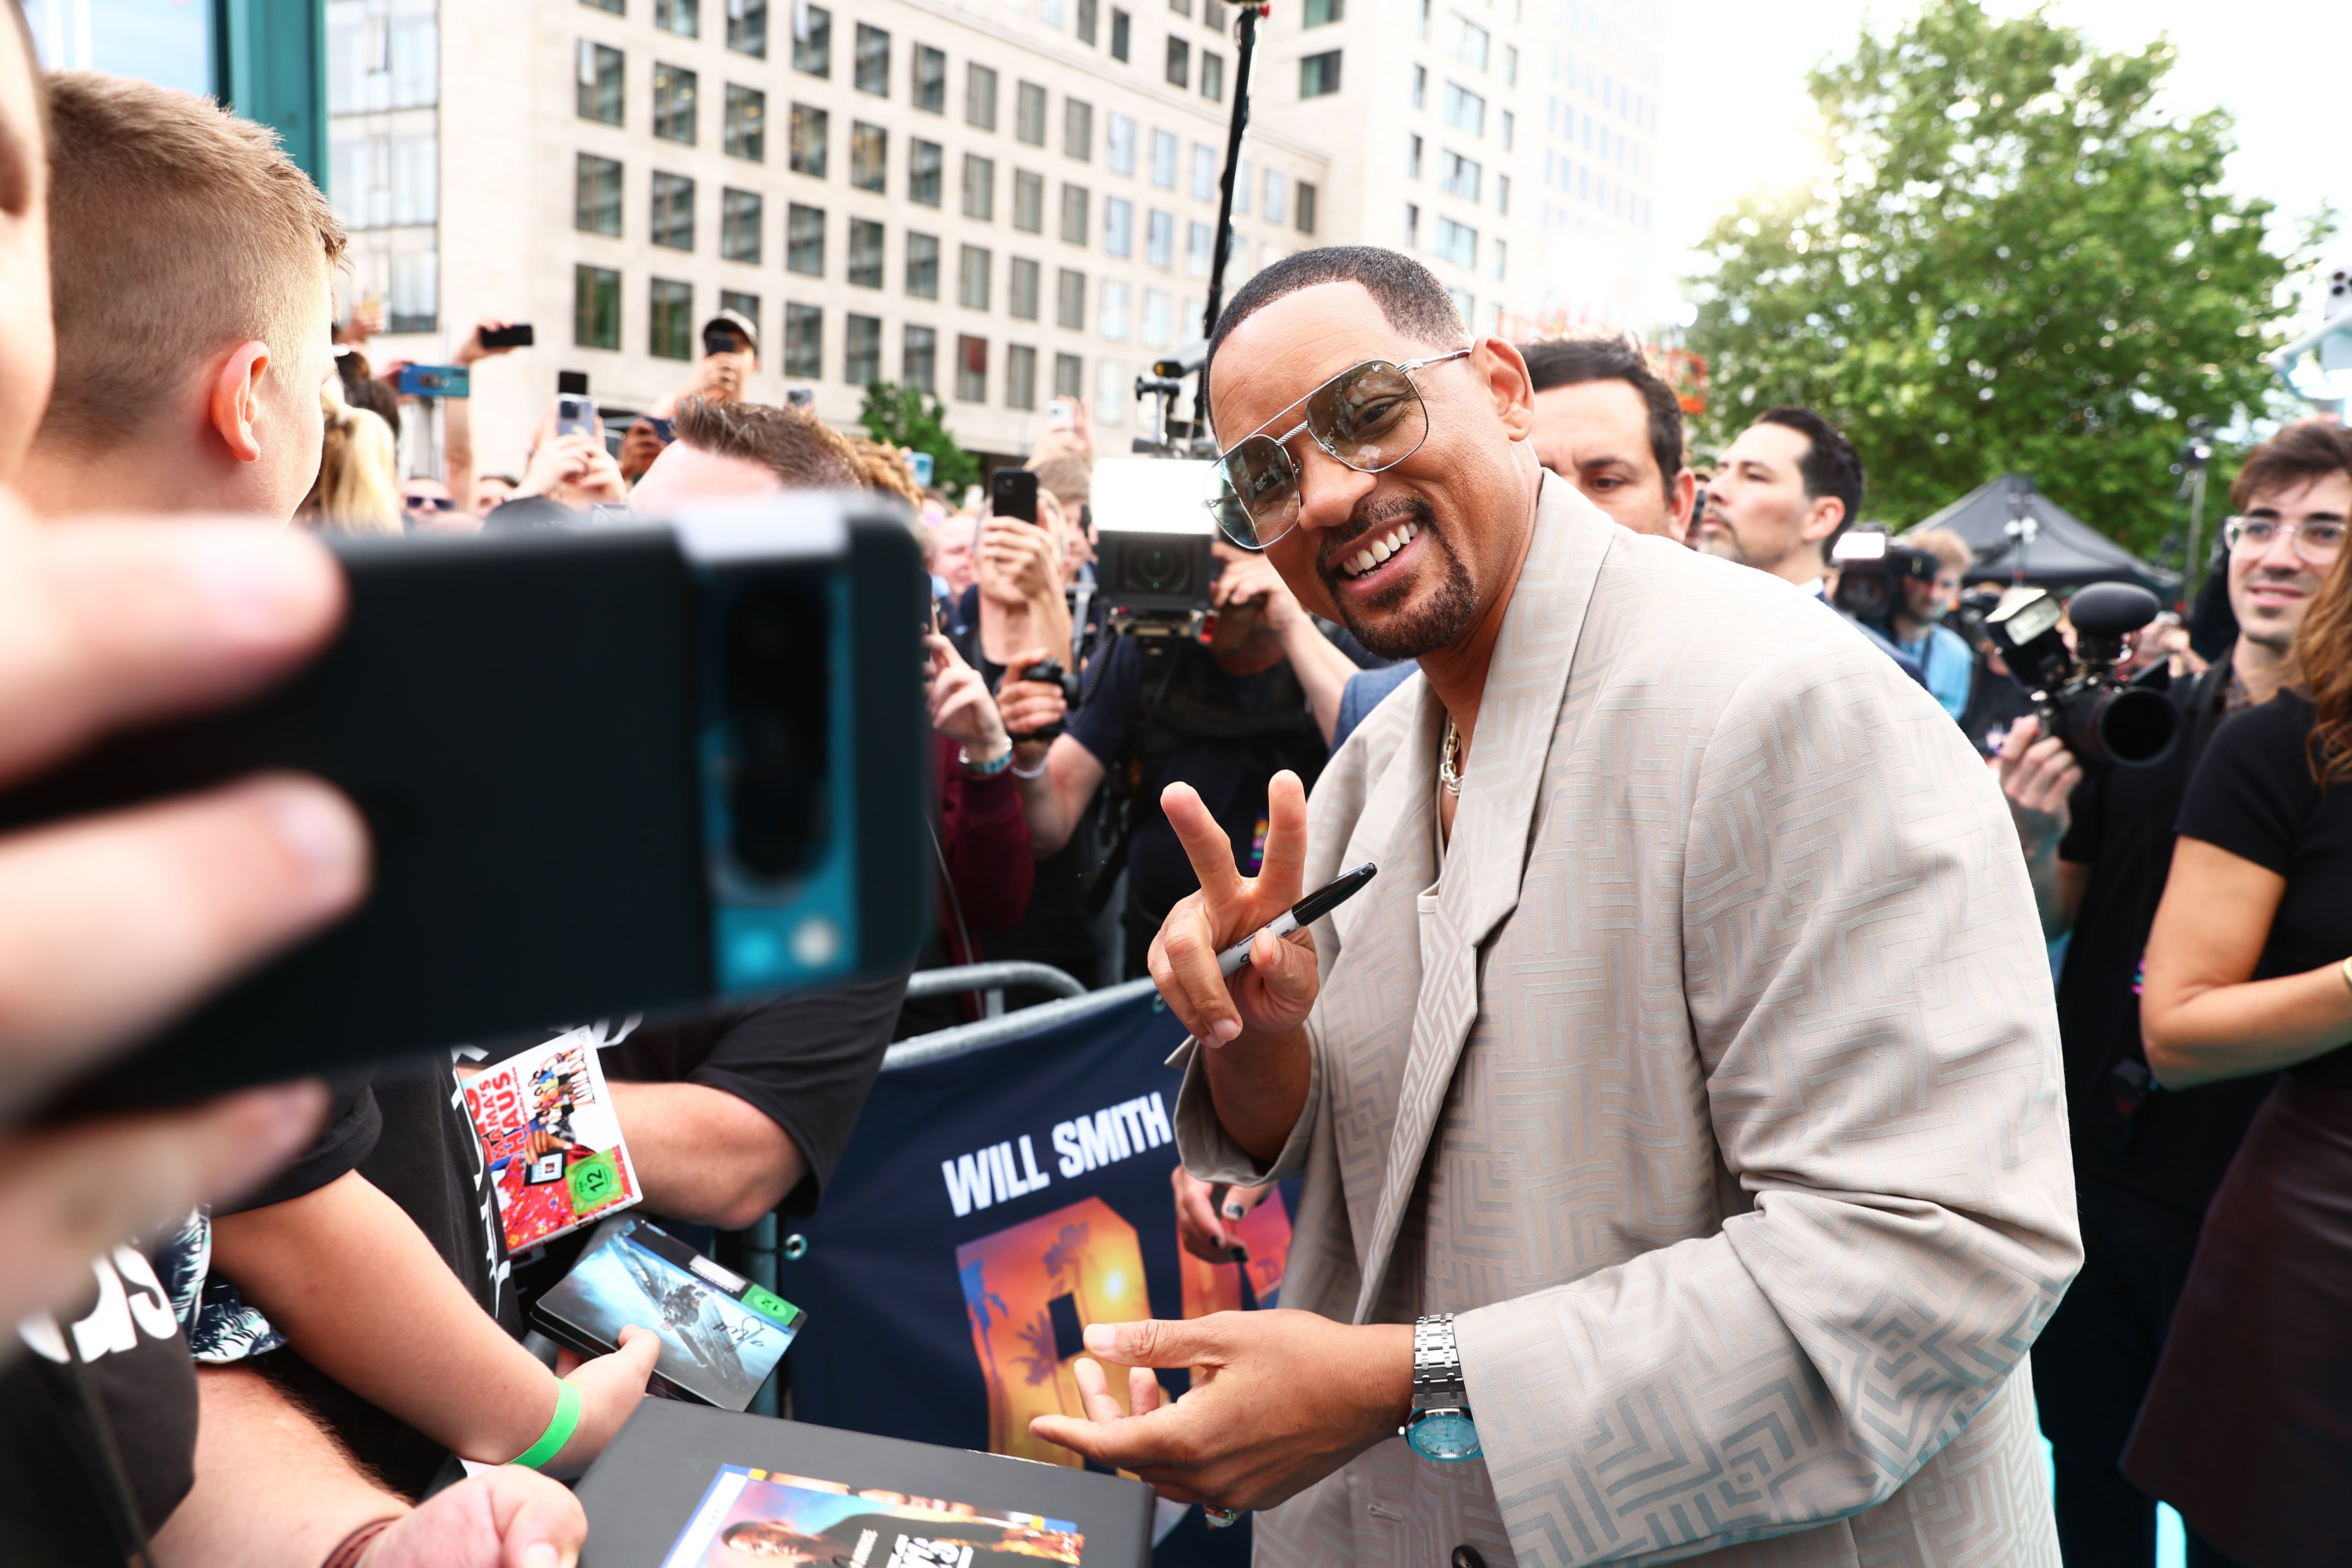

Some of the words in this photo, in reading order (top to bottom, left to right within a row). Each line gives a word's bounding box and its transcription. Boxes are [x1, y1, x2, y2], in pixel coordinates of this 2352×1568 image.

[479, 1079, 507, 1161] MAMA'S
[492, 1071, 528, 1156] HAUS
[941, 1134, 1051, 1218] WILL
[1051, 1091, 1173, 1179] SMITH
[587, 1169, 604, 1192] 12
